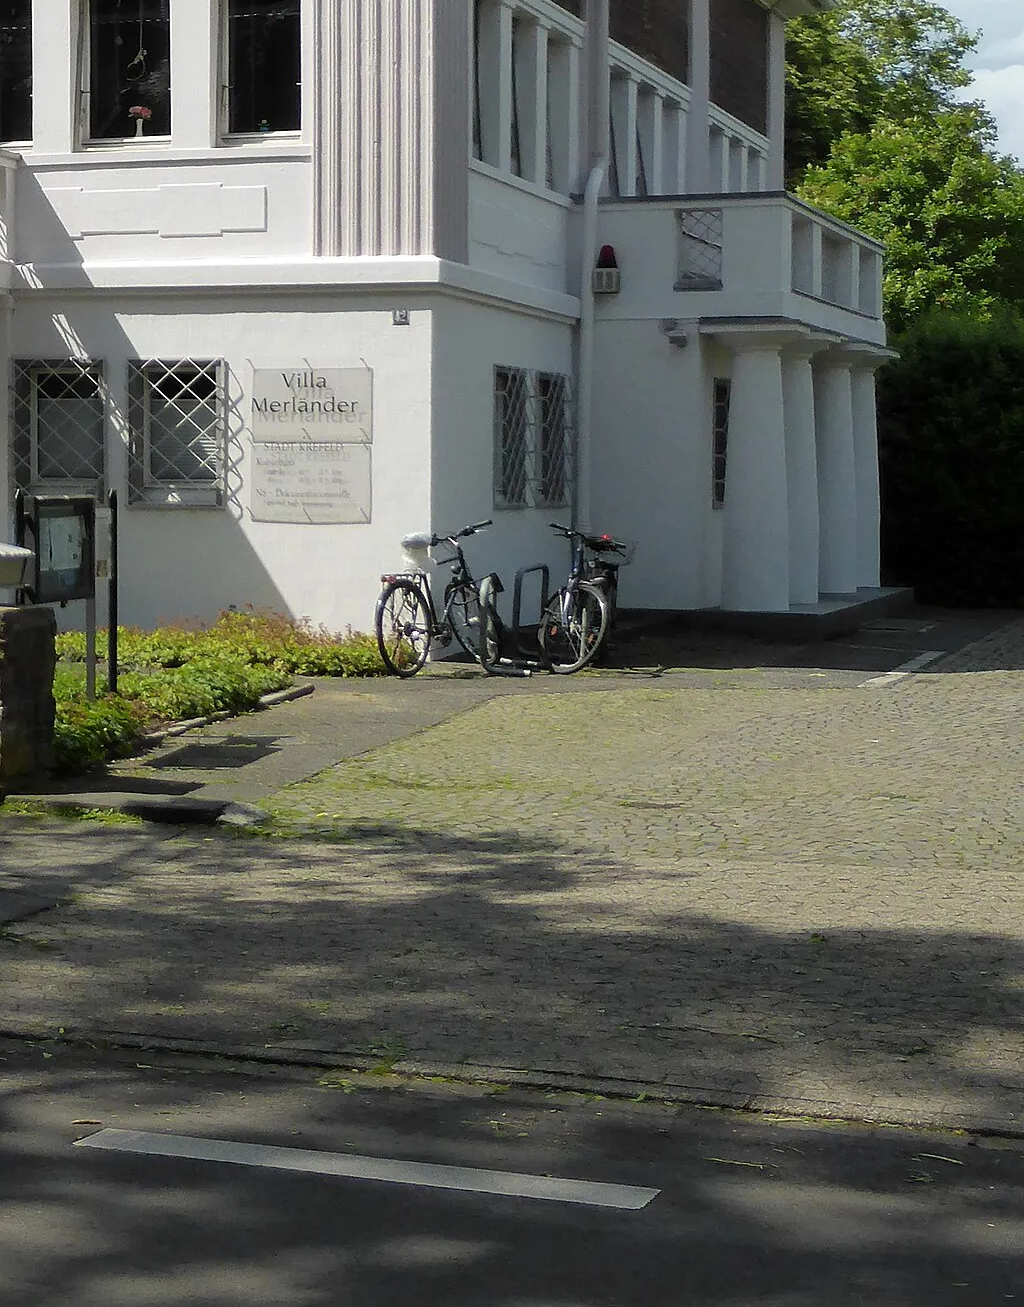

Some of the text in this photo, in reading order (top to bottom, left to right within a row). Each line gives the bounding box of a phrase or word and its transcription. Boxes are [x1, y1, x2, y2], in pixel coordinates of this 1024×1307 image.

[282, 372, 327, 388] Villa
[251, 397, 359, 413] Merländer
[264, 443, 344, 452] STADT KREFELD
